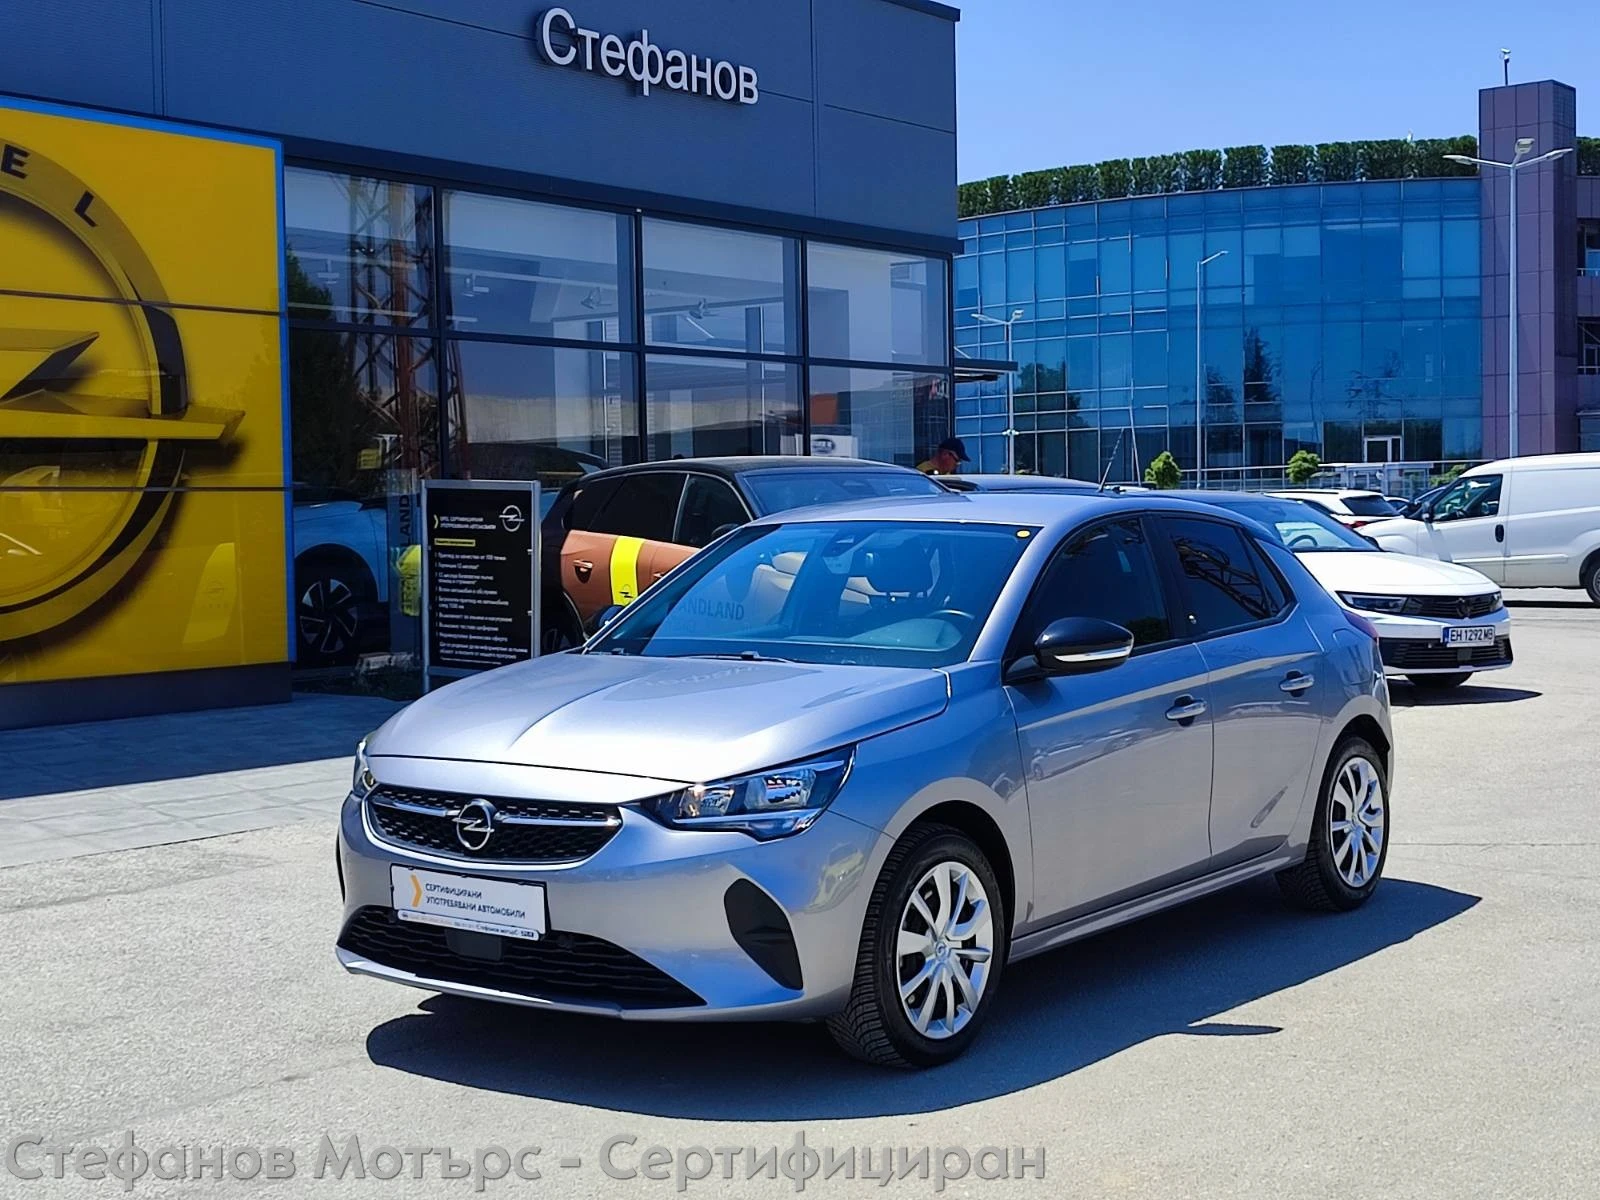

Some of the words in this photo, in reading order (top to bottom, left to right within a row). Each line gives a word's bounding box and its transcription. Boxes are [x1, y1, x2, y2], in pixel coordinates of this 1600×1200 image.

[542, 7, 759, 105] Стефанов
[425, 883, 482, 899] СЕРТИФИЦИРАНИ
[477, 903, 526, 919] АВТОМОБИЛИ
